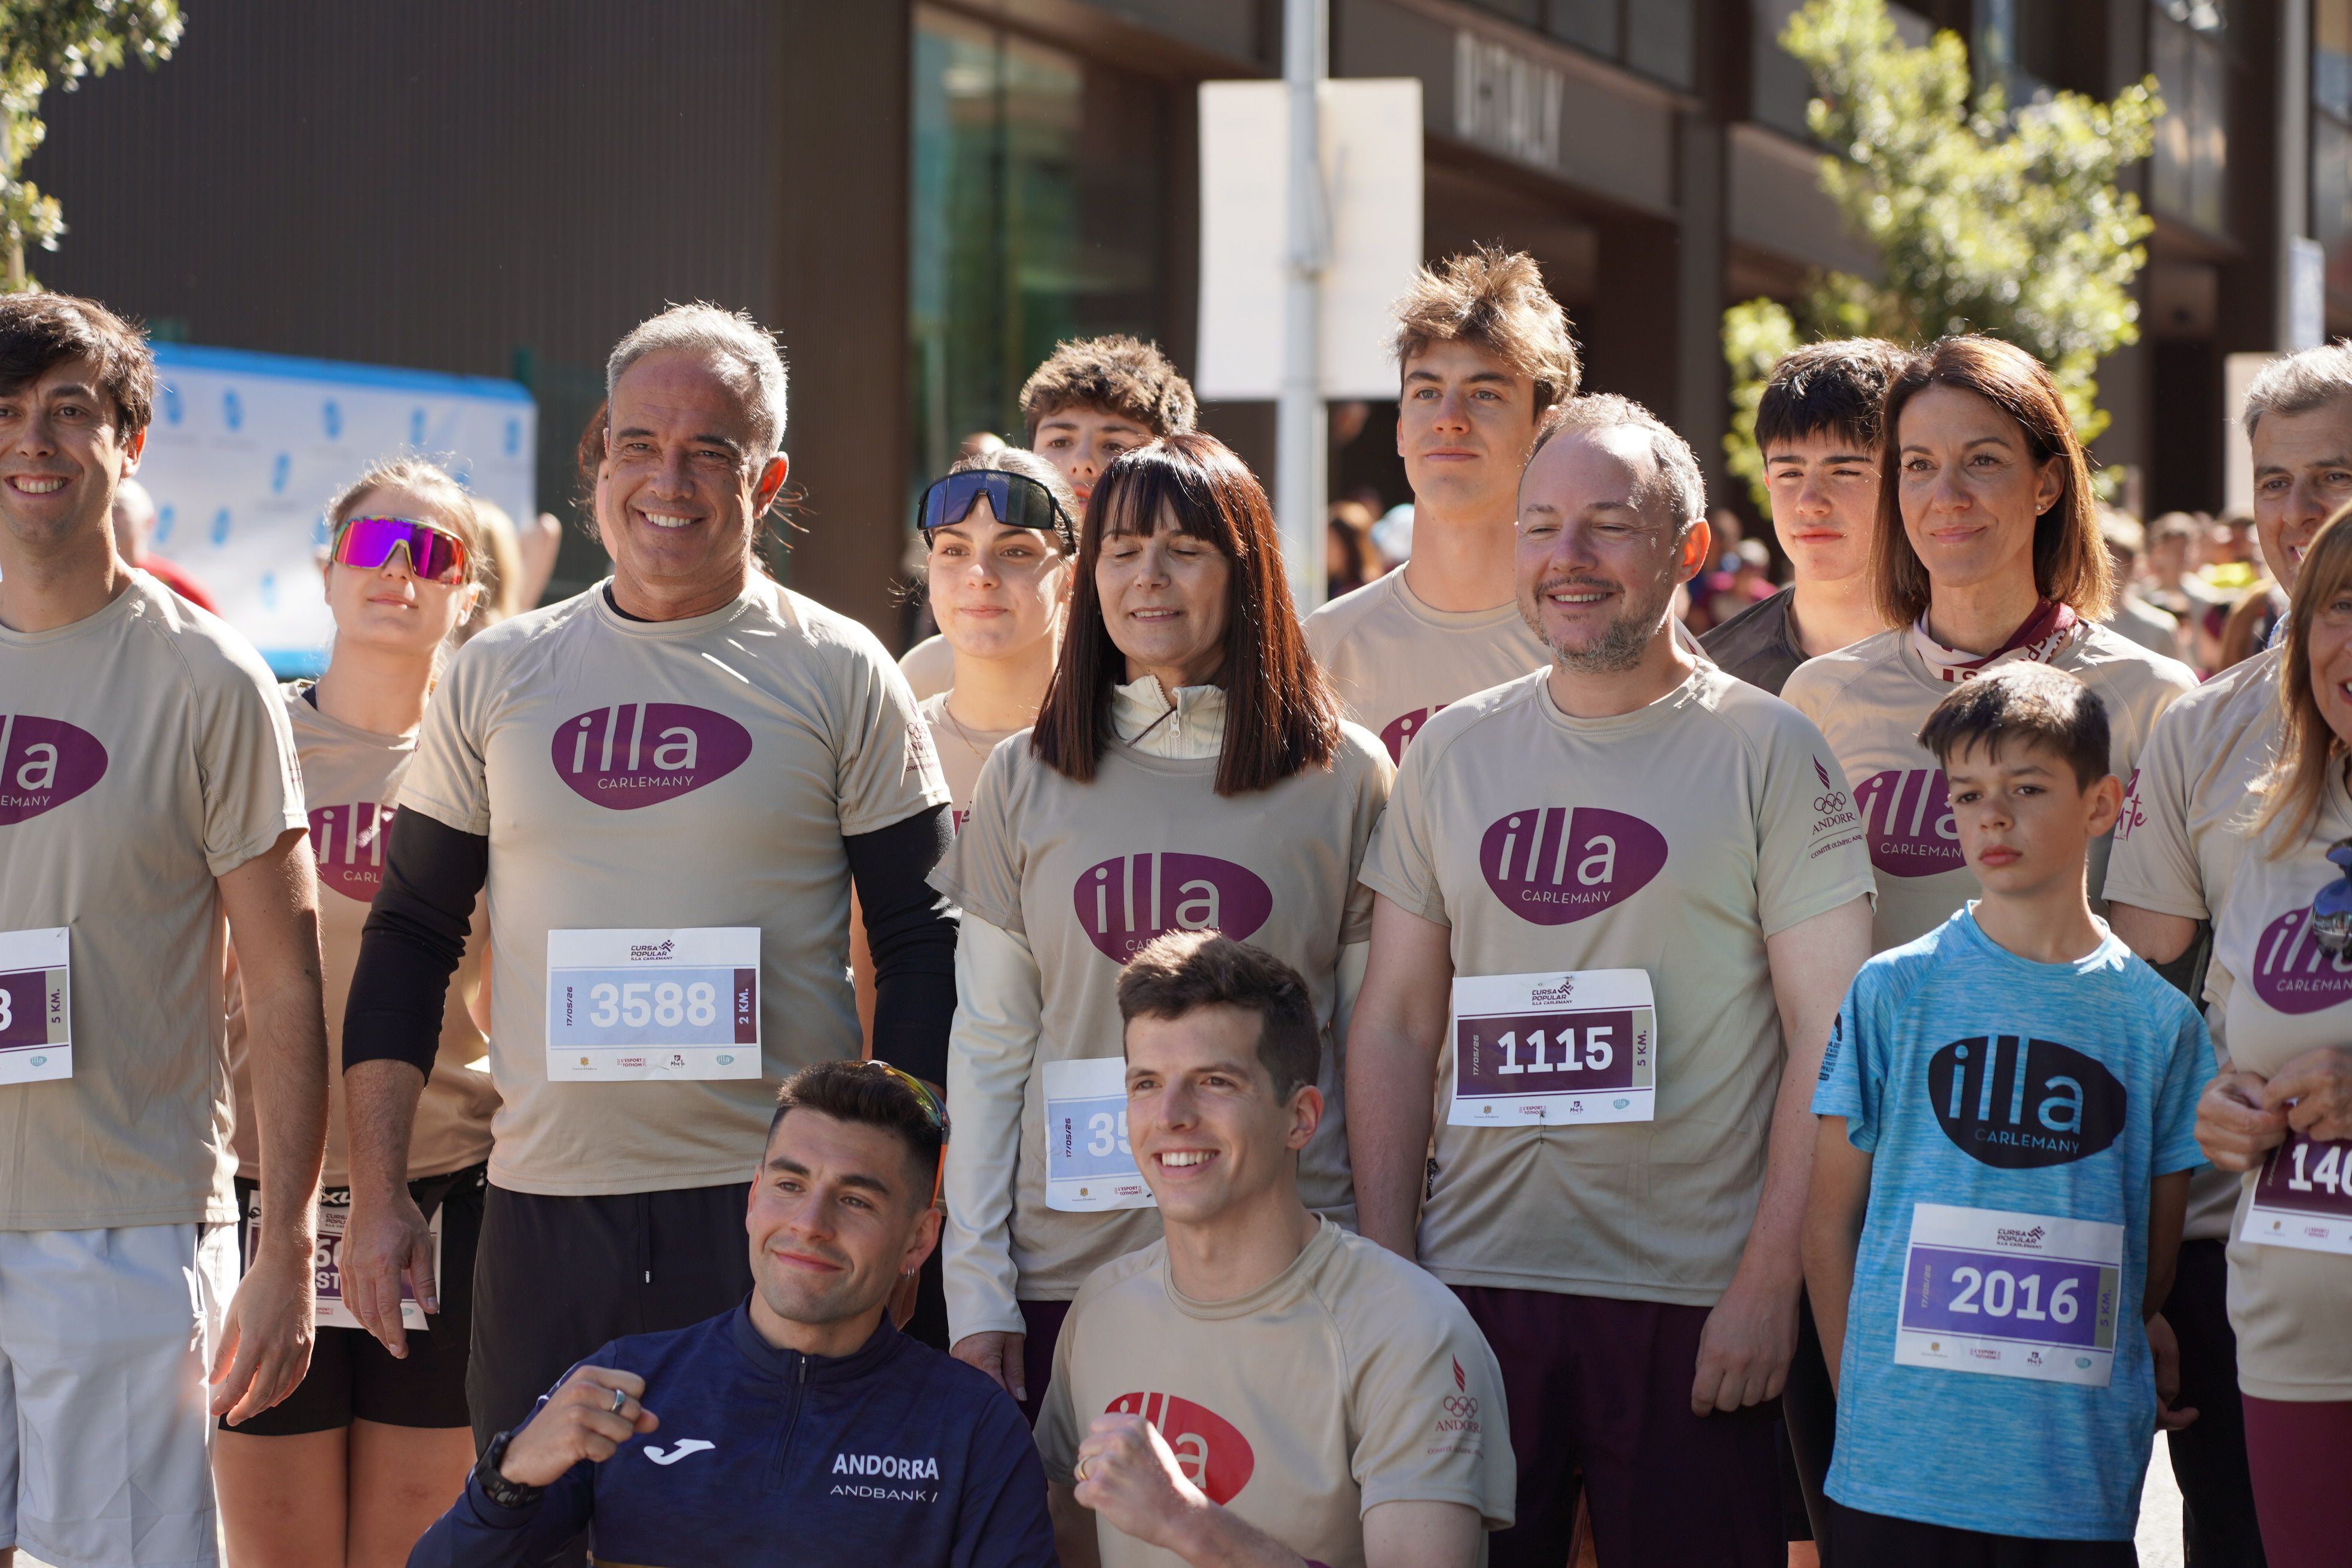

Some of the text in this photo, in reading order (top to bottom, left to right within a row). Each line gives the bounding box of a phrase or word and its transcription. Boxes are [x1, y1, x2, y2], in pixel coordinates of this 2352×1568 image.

[572, 703, 698, 773] illa
[598, 775, 694, 789] CARLEMANY
[1499, 807, 1616, 886] illa
[1096, 852, 1220, 933] illa
[1522, 890, 1611, 904] CARLEMANY
[51, 988, 60, 1012] KM.
[590, 982, 716, 1028] 3588
[739, 988, 749, 1025] 2 KM.
[1497, 1025, 1613, 1075] 1115
[1638, 1030, 1647, 1055] KM.
[1949, 1034, 2084, 1134] illa
[1975, 1128, 2080, 1154] CARLEMANY
[1998, 1235, 2036, 1244] POPULAR
[1949, 1266, 2079, 1324] 2016
[2101, 1290, 2111, 1315] KM.
[832, 1453, 939, 1480] ANDORRA
[831, 1484, 926, 1502] ANDBANK
